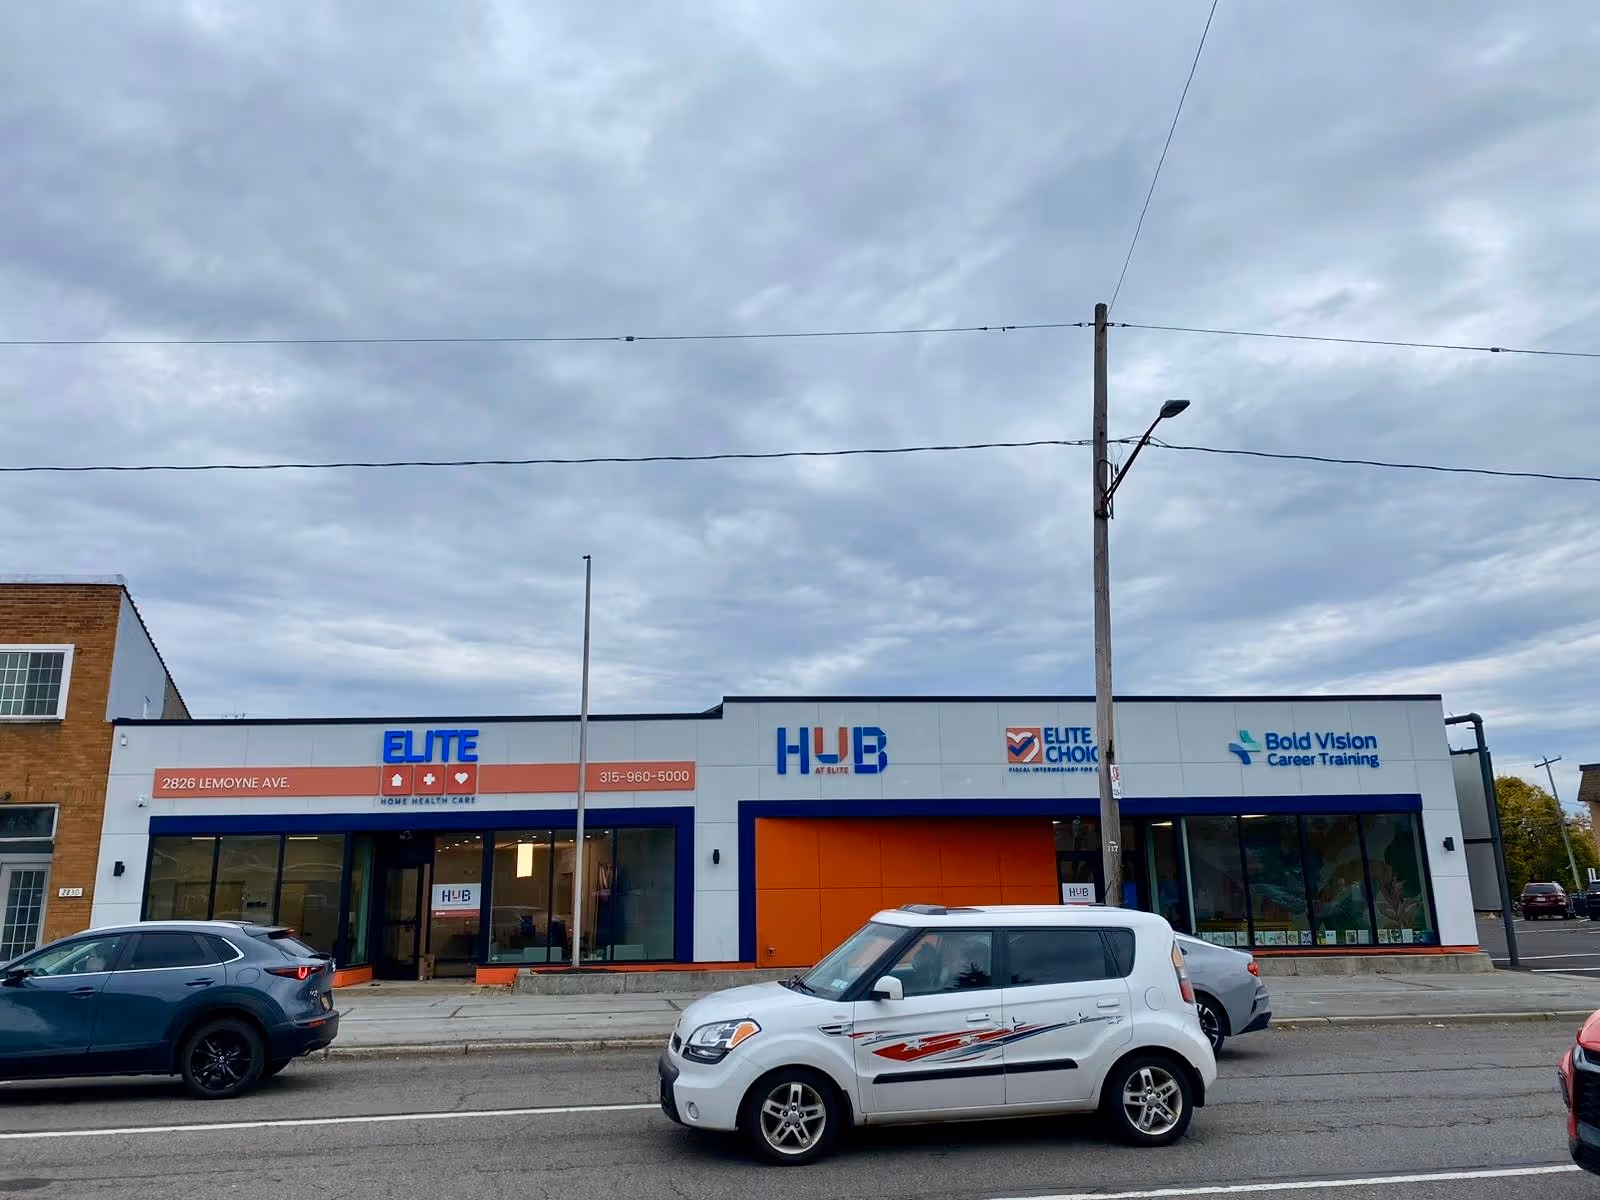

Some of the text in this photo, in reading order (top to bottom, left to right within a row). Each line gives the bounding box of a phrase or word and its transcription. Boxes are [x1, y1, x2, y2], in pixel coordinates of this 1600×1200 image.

[1044, 727, 1092, 744] ELITE
[1265, 732, 1377, 750] Bold Vision
[383, 729, 479, 763] ELITE
[777, 726, 888, 775] HUB
[1046, 746, 1099, 763] CHOIC
[1267, 752, 1380, 768] Career Training
[162, 776, 290, 790] 2826 LEMOYNE AVE.
[600, 770, 689, 783] 315-960-5000
[381, 796, 476, 806] HOME HEALTH CARE
[442, 889, 471, 902] HUB
[1069, 887, 1089, 897] HUB
